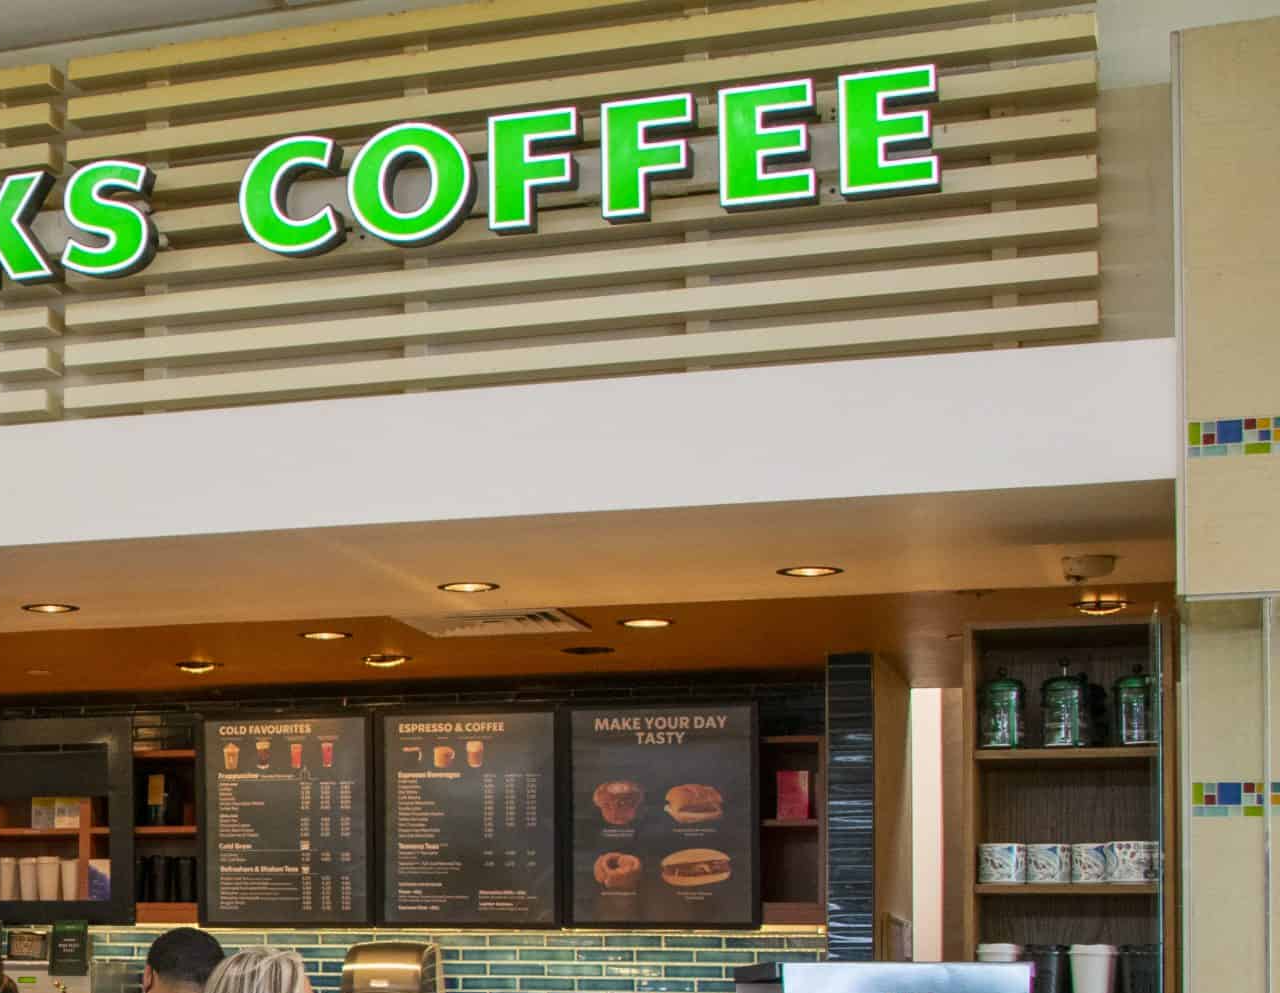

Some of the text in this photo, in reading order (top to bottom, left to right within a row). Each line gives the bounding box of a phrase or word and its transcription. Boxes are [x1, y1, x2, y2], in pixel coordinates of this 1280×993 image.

[238, 63, 940, 255] COFFEE
[398, 722, 452, 733] ESPRESSO
[465, 721, 504, 732] COFFEE
[594, 715, 728, 731] MAKE YOUR DAY
[219, 724, 312, 736] COLD FAVOURITES
[636, 732, 685, 745] TASTY
